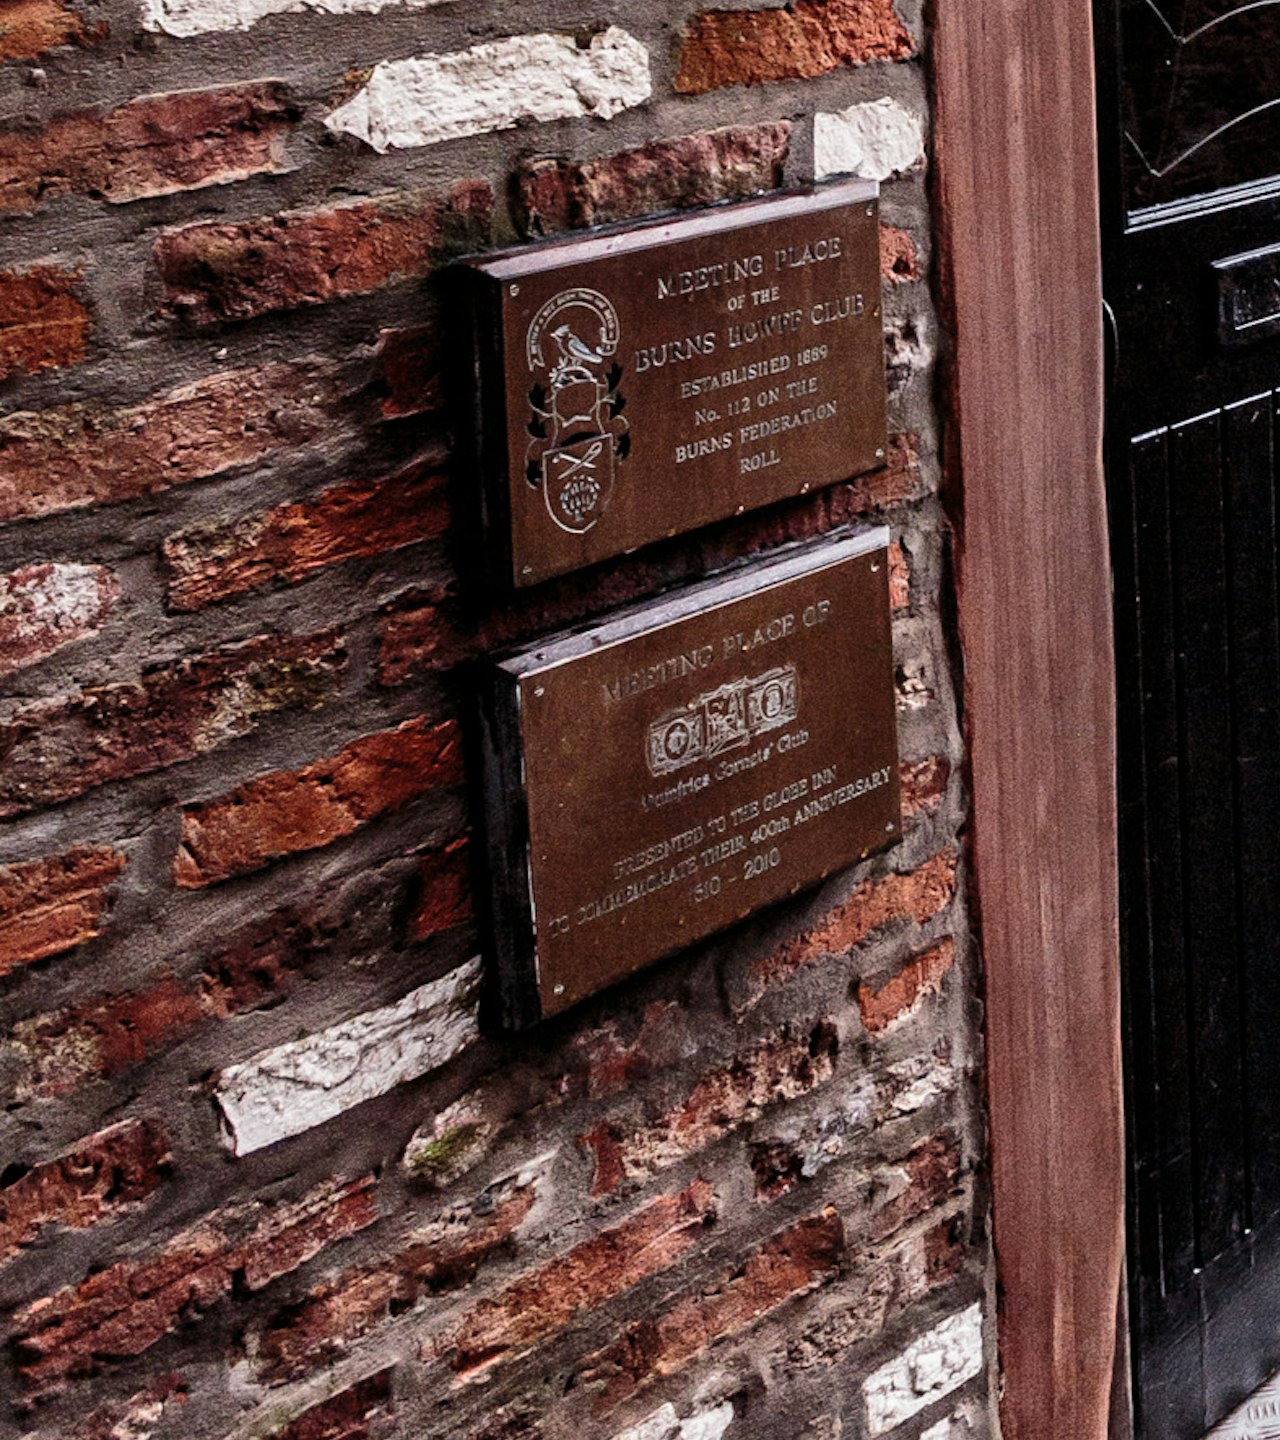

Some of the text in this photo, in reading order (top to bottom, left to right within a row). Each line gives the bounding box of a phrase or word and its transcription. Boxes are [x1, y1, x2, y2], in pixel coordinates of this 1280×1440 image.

[657, 237, 842, 300] MEETING PLACE
[727, 286, 781, 312] OF THE
[634, 294, 865, 372] BURNS HOWFF CLUB
[681, 345, 828, 399] ESTABLISHED 1889
[694, 377, 818, 427] No. 112 ON THE
[675, 400, 838, 464] BURNS FEDERATION
[740, 449, 781, 475] ROLL
[602, 600, 831, 706] MEETING PLACE OF
[777, 729, 810, 754] Club
[613, 765, 838, 880] PRESENTED TO THE GLOBE INN
[548, 766, 892, 940] TO COMMEMORATE THEIR 400th ANNIVERSARY
[743, 847, 781, 880] 2010
